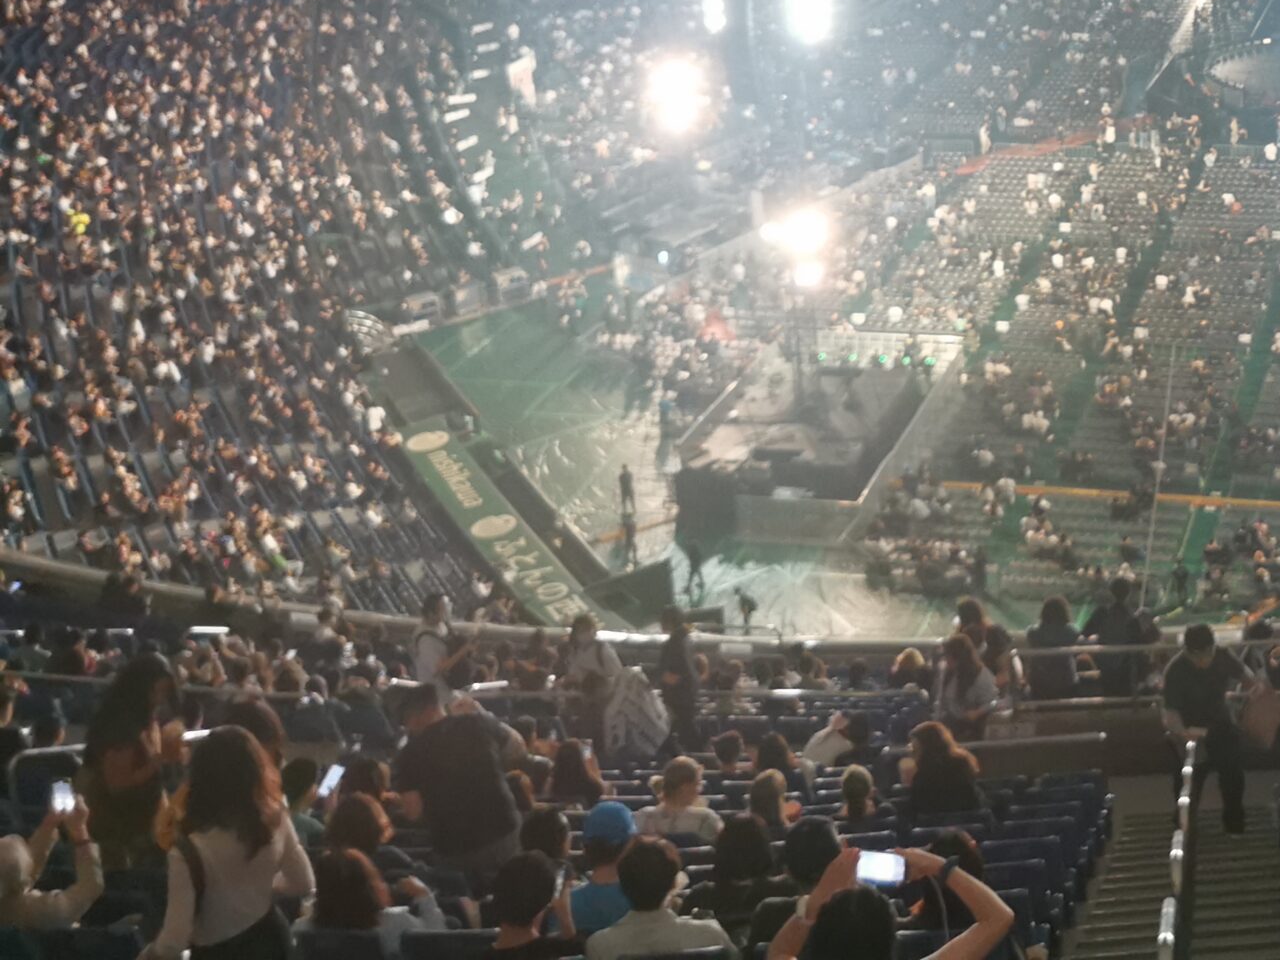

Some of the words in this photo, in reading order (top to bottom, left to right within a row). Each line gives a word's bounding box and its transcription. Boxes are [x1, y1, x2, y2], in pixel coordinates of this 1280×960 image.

[428, 449, 483, 509] nishikawa
[493, 536, 600, 623] ふとんの西
